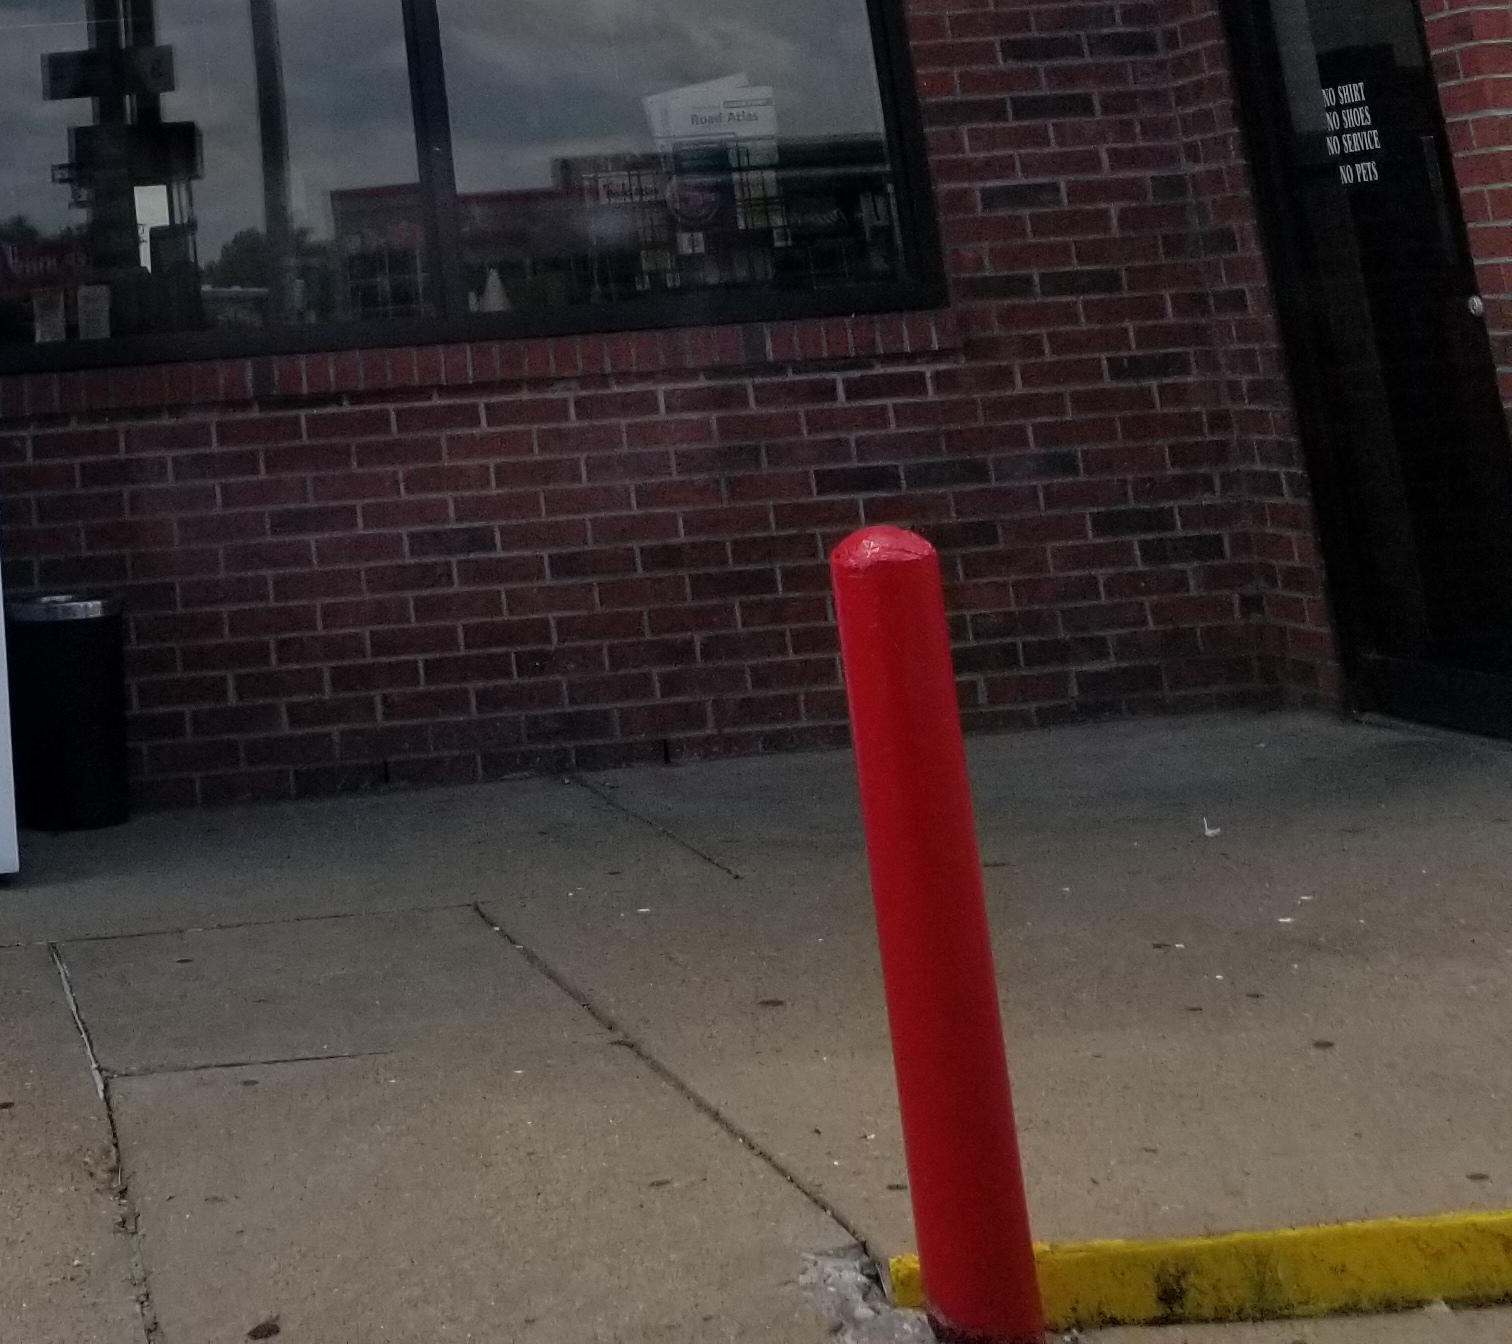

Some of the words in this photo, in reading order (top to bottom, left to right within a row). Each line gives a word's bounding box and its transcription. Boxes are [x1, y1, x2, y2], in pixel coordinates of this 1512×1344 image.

[1322, 88, 1336, 107] NO
[1338, 82, 1365, 105] SHIRT
[1326, 111, 1340, 131] NO
[1342, 106, 1372, 128] SHOES
[1327, 136, 1341, 155] NO
[1342, 130, 1381, 153] SERVICE
[1339, 165, 1354, 184] NO
[1355, 161, 1379, 182] PETS
